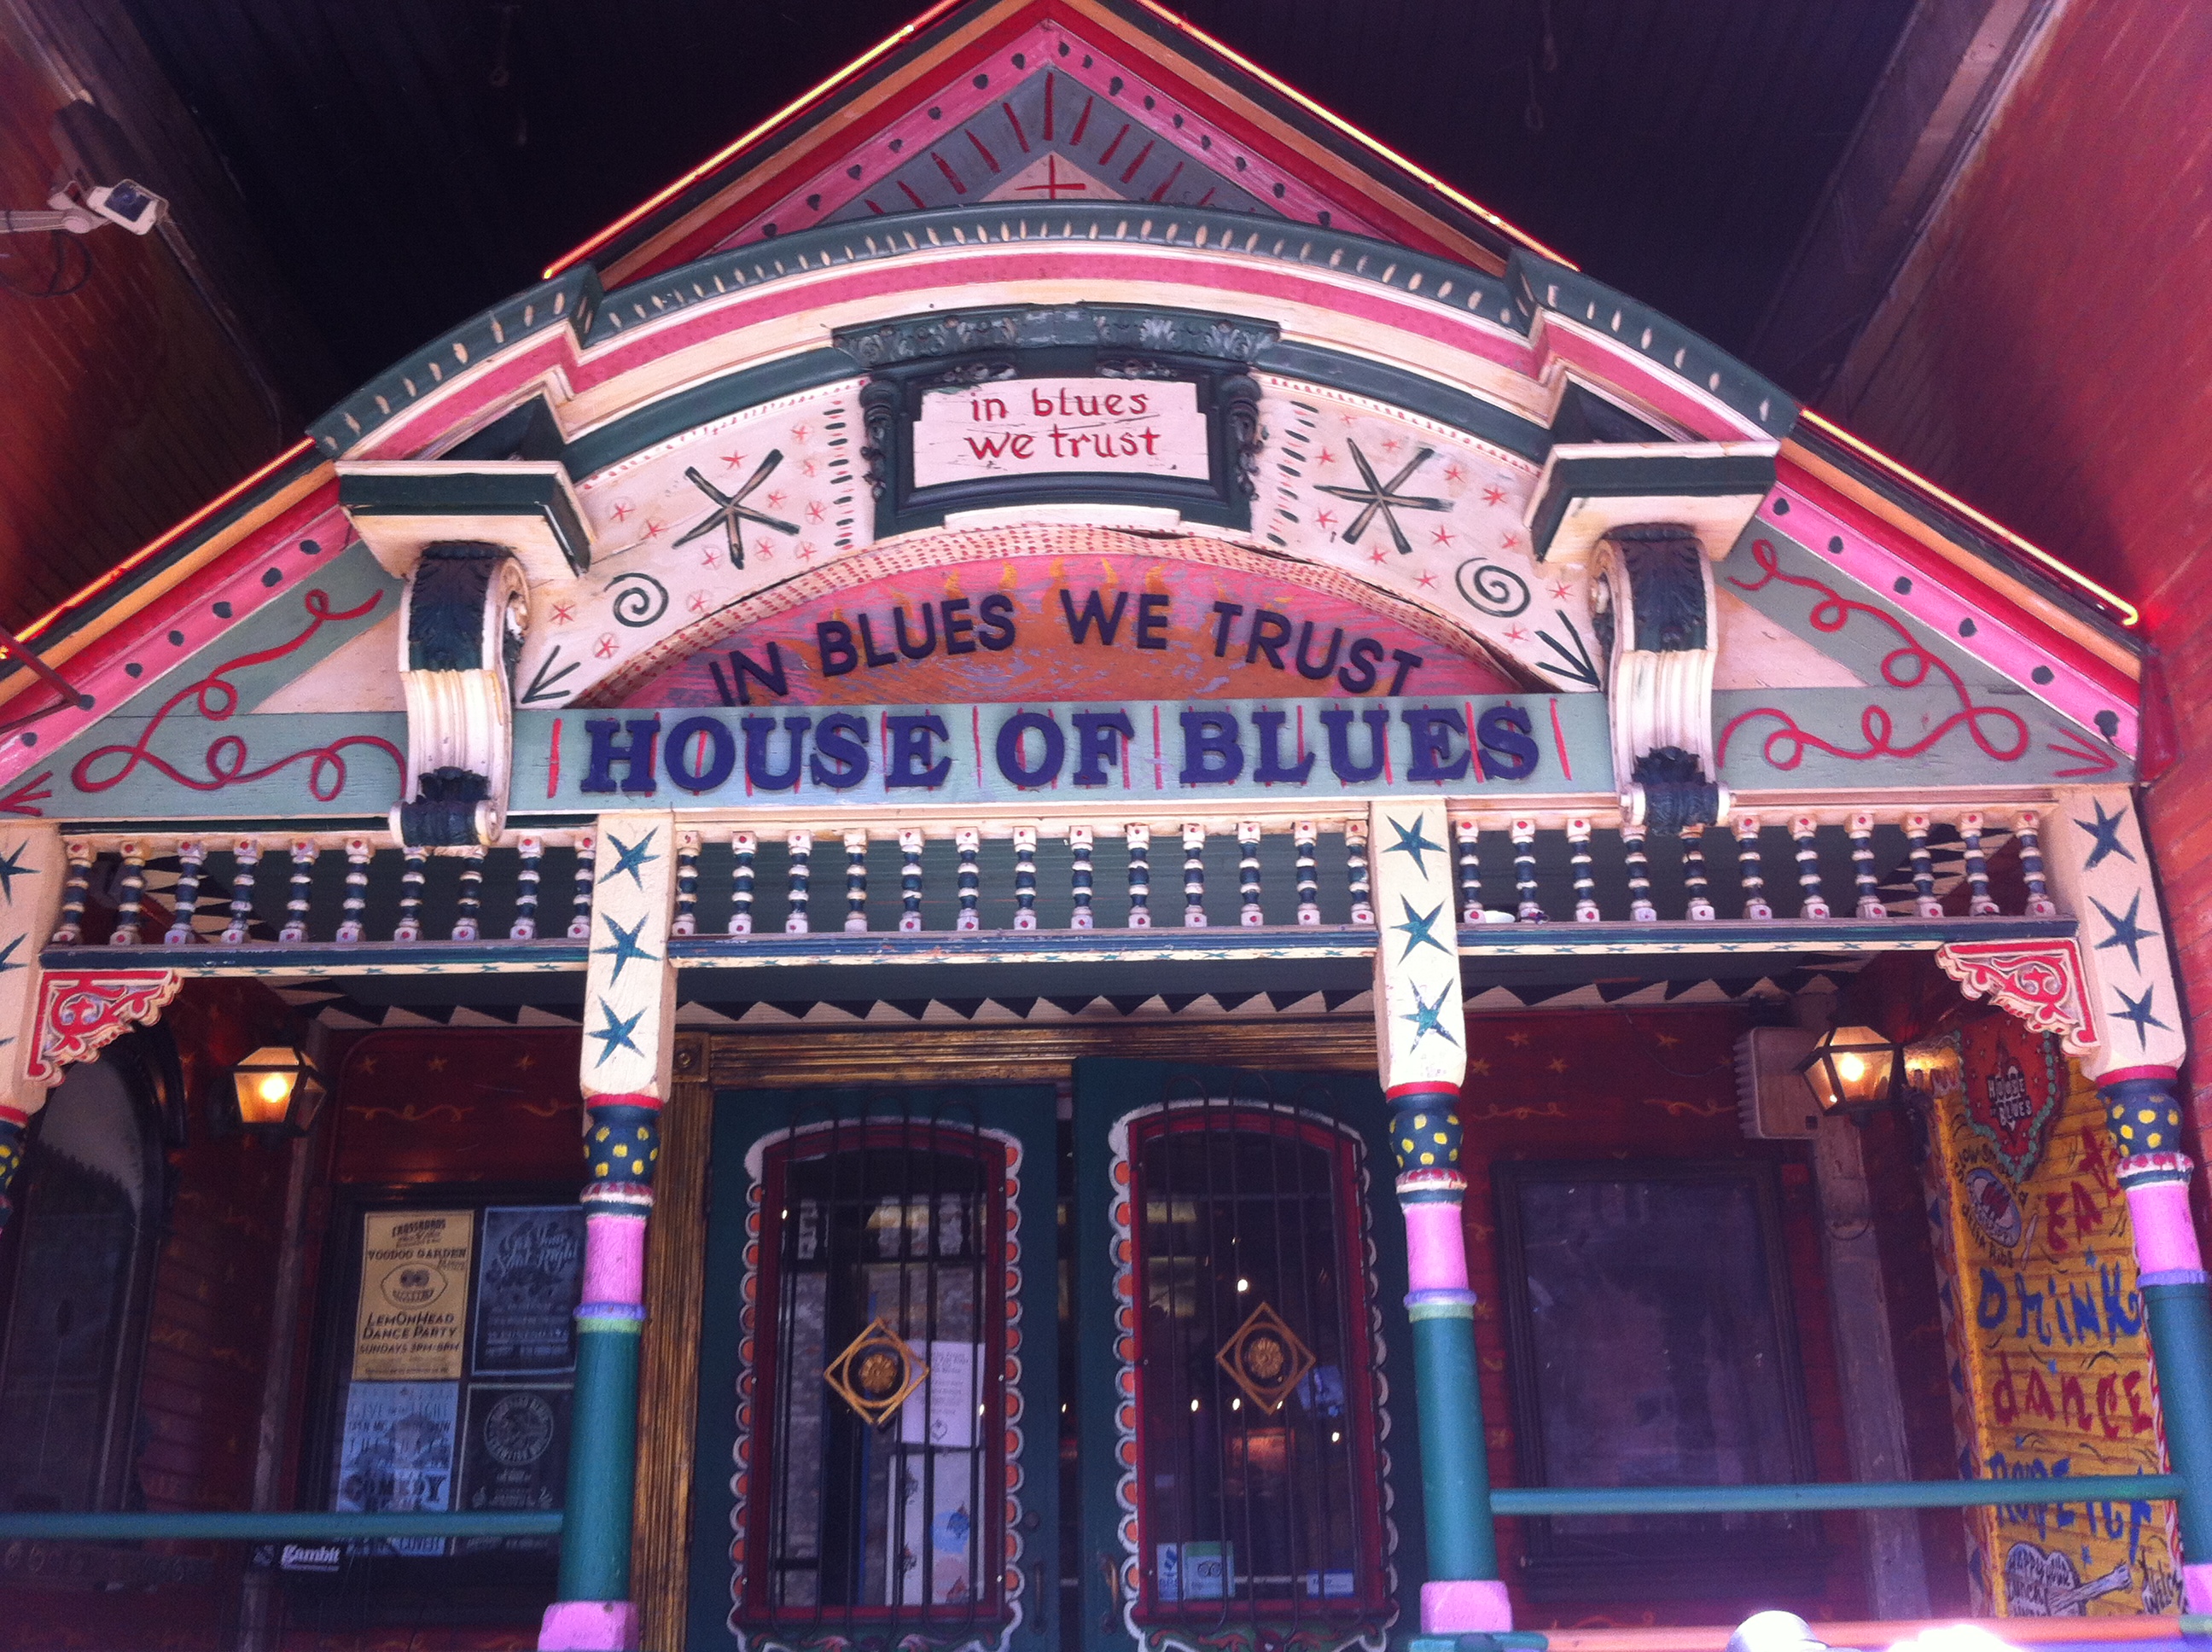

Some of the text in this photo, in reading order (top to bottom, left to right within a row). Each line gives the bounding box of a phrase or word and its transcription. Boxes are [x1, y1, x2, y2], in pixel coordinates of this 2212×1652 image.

[971, 387, 1149, 421] in blues
[964, 424, 1161, 460] we trust
[709, 589, 1423, 707] IN BLUES WE TRUST
[579, 706, 1540, 794] HOUSE OF BLUES
[368, 1248, 467, 1261] VOODOO GARDEN
[363, 1324, 457, 1340] DANCE PARTY
